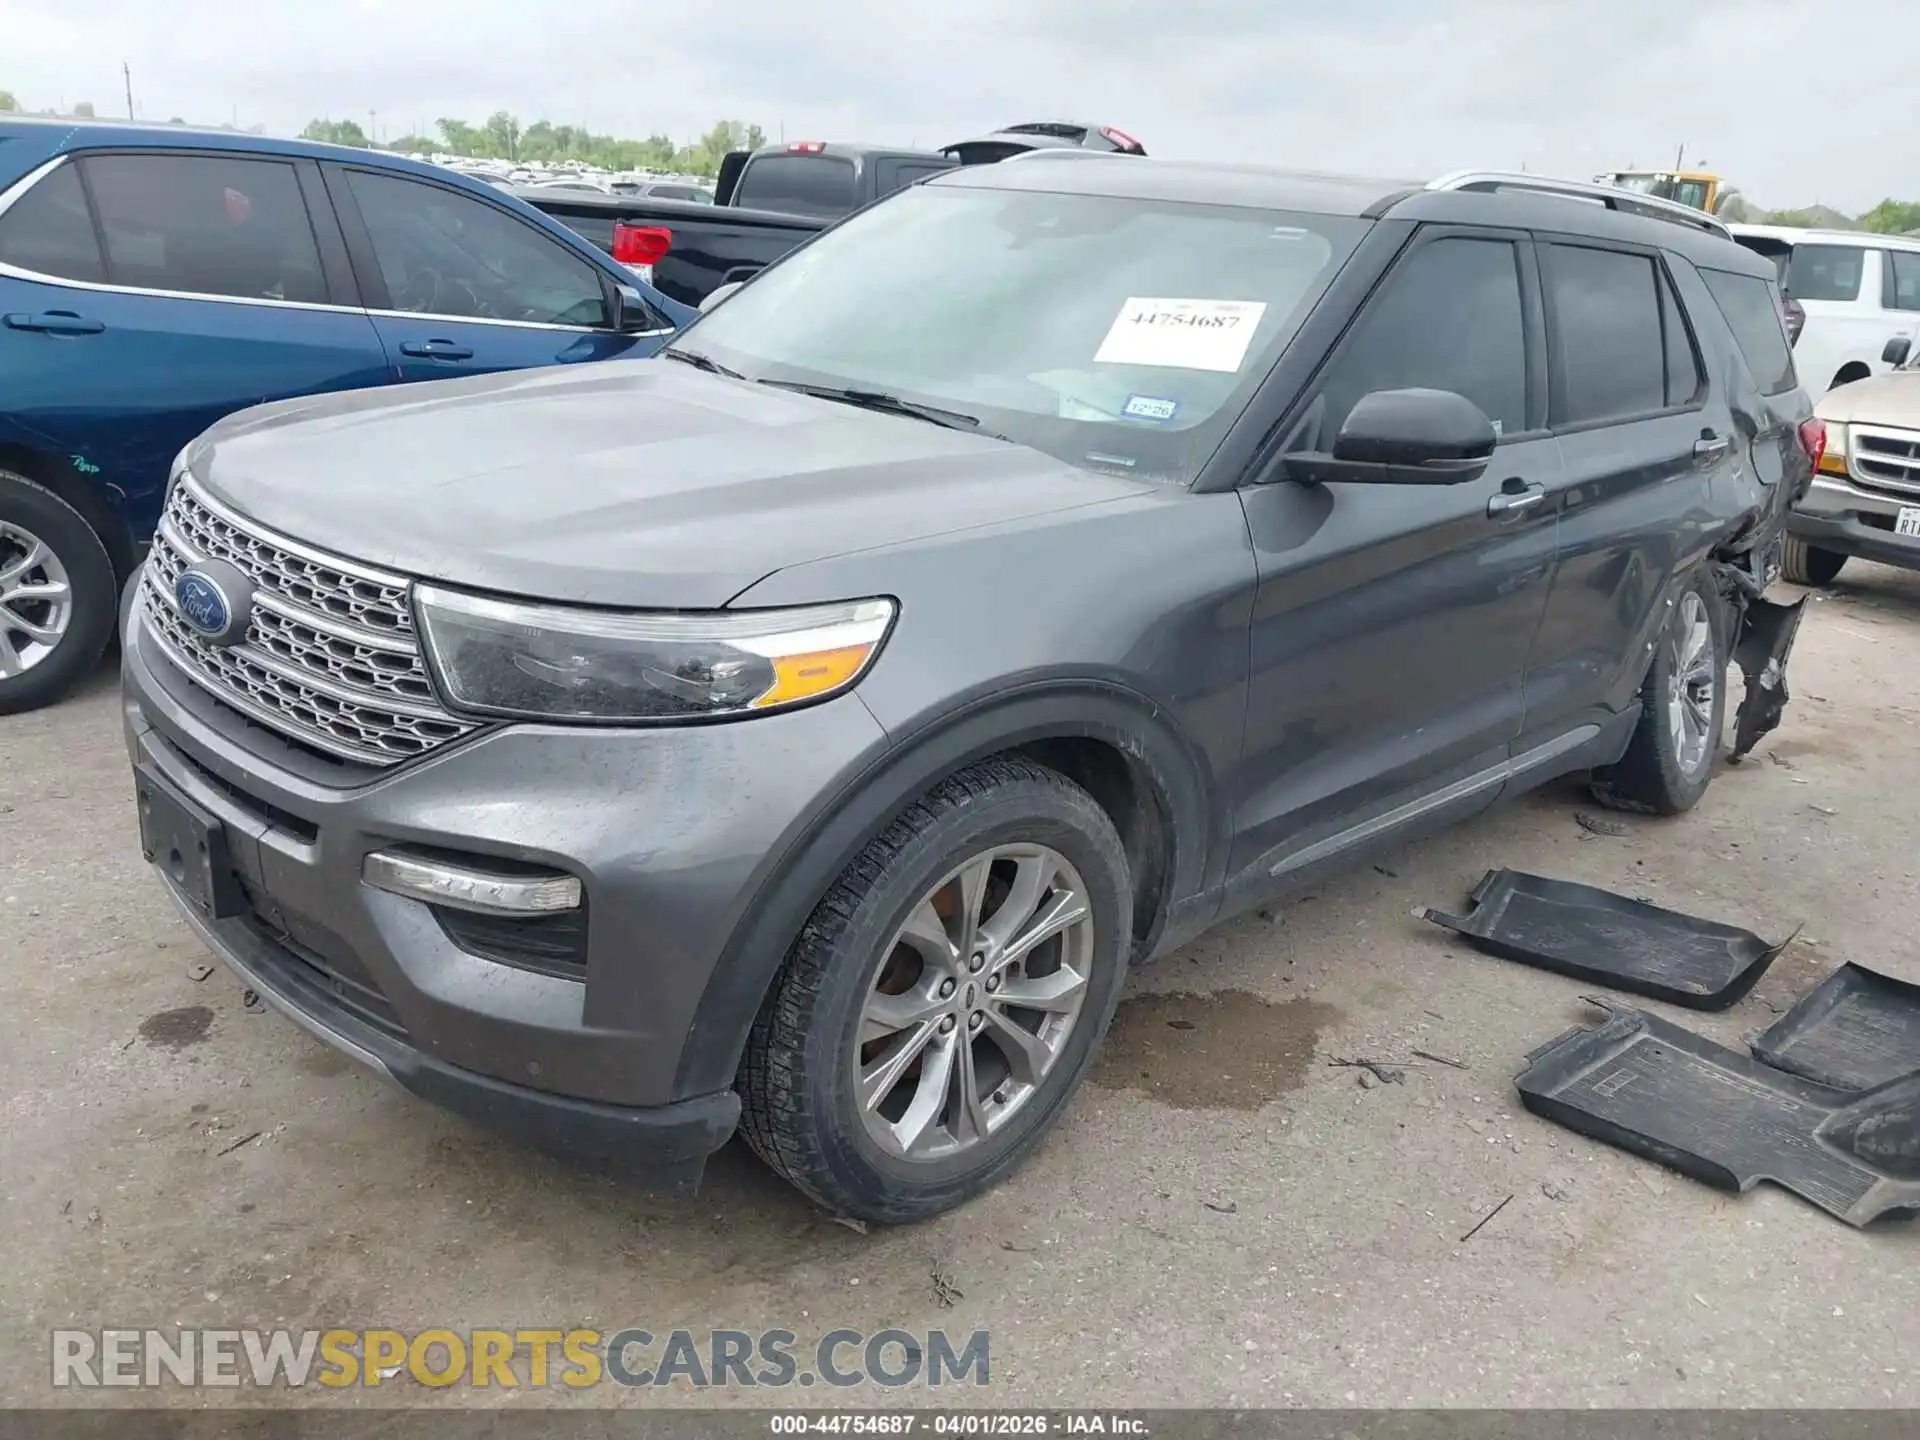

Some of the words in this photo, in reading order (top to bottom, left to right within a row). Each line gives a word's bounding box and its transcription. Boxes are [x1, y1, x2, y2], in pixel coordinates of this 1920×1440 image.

[1129, 312, 1240, 328] 44754687
[1899, 519, 1920, 536] RT
[181, 582, 214, 624] Ford
